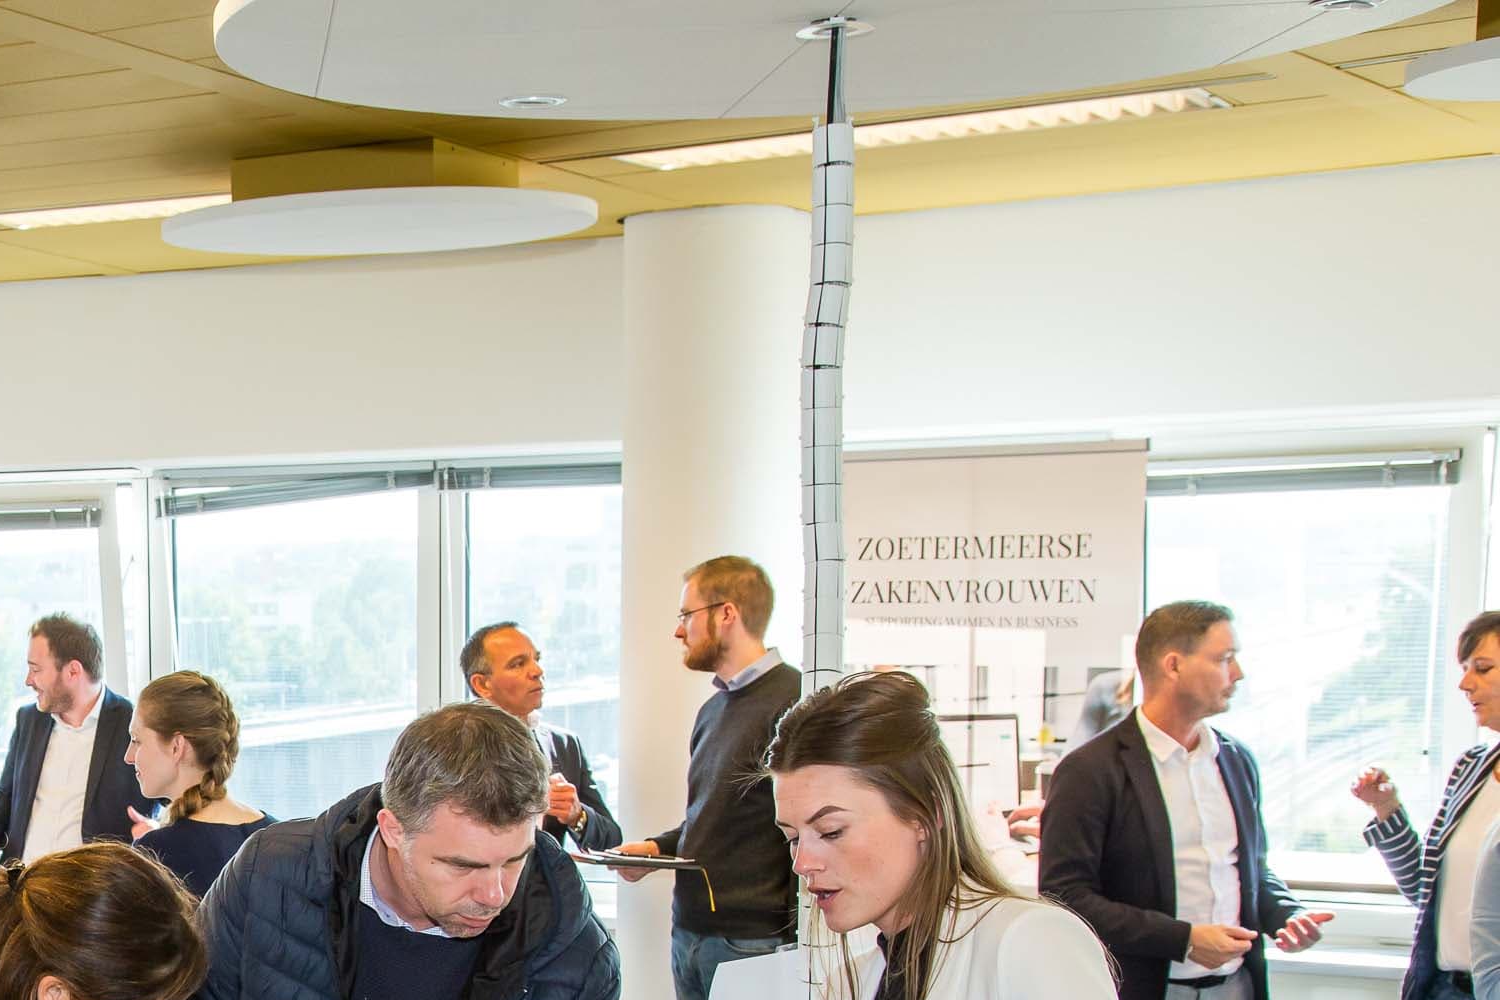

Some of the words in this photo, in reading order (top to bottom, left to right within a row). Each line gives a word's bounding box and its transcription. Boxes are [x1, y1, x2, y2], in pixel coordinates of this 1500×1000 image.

[857, 533, 1093, 561] ZOETERMEERSE
[851, 578, 1098, 604] ZAKENVROUWEN
[946, 616, 998, 628] WOMEN
[1000, 616, 1013, 627] IN
[1016, 616, 1079, 629] BUSINESS
